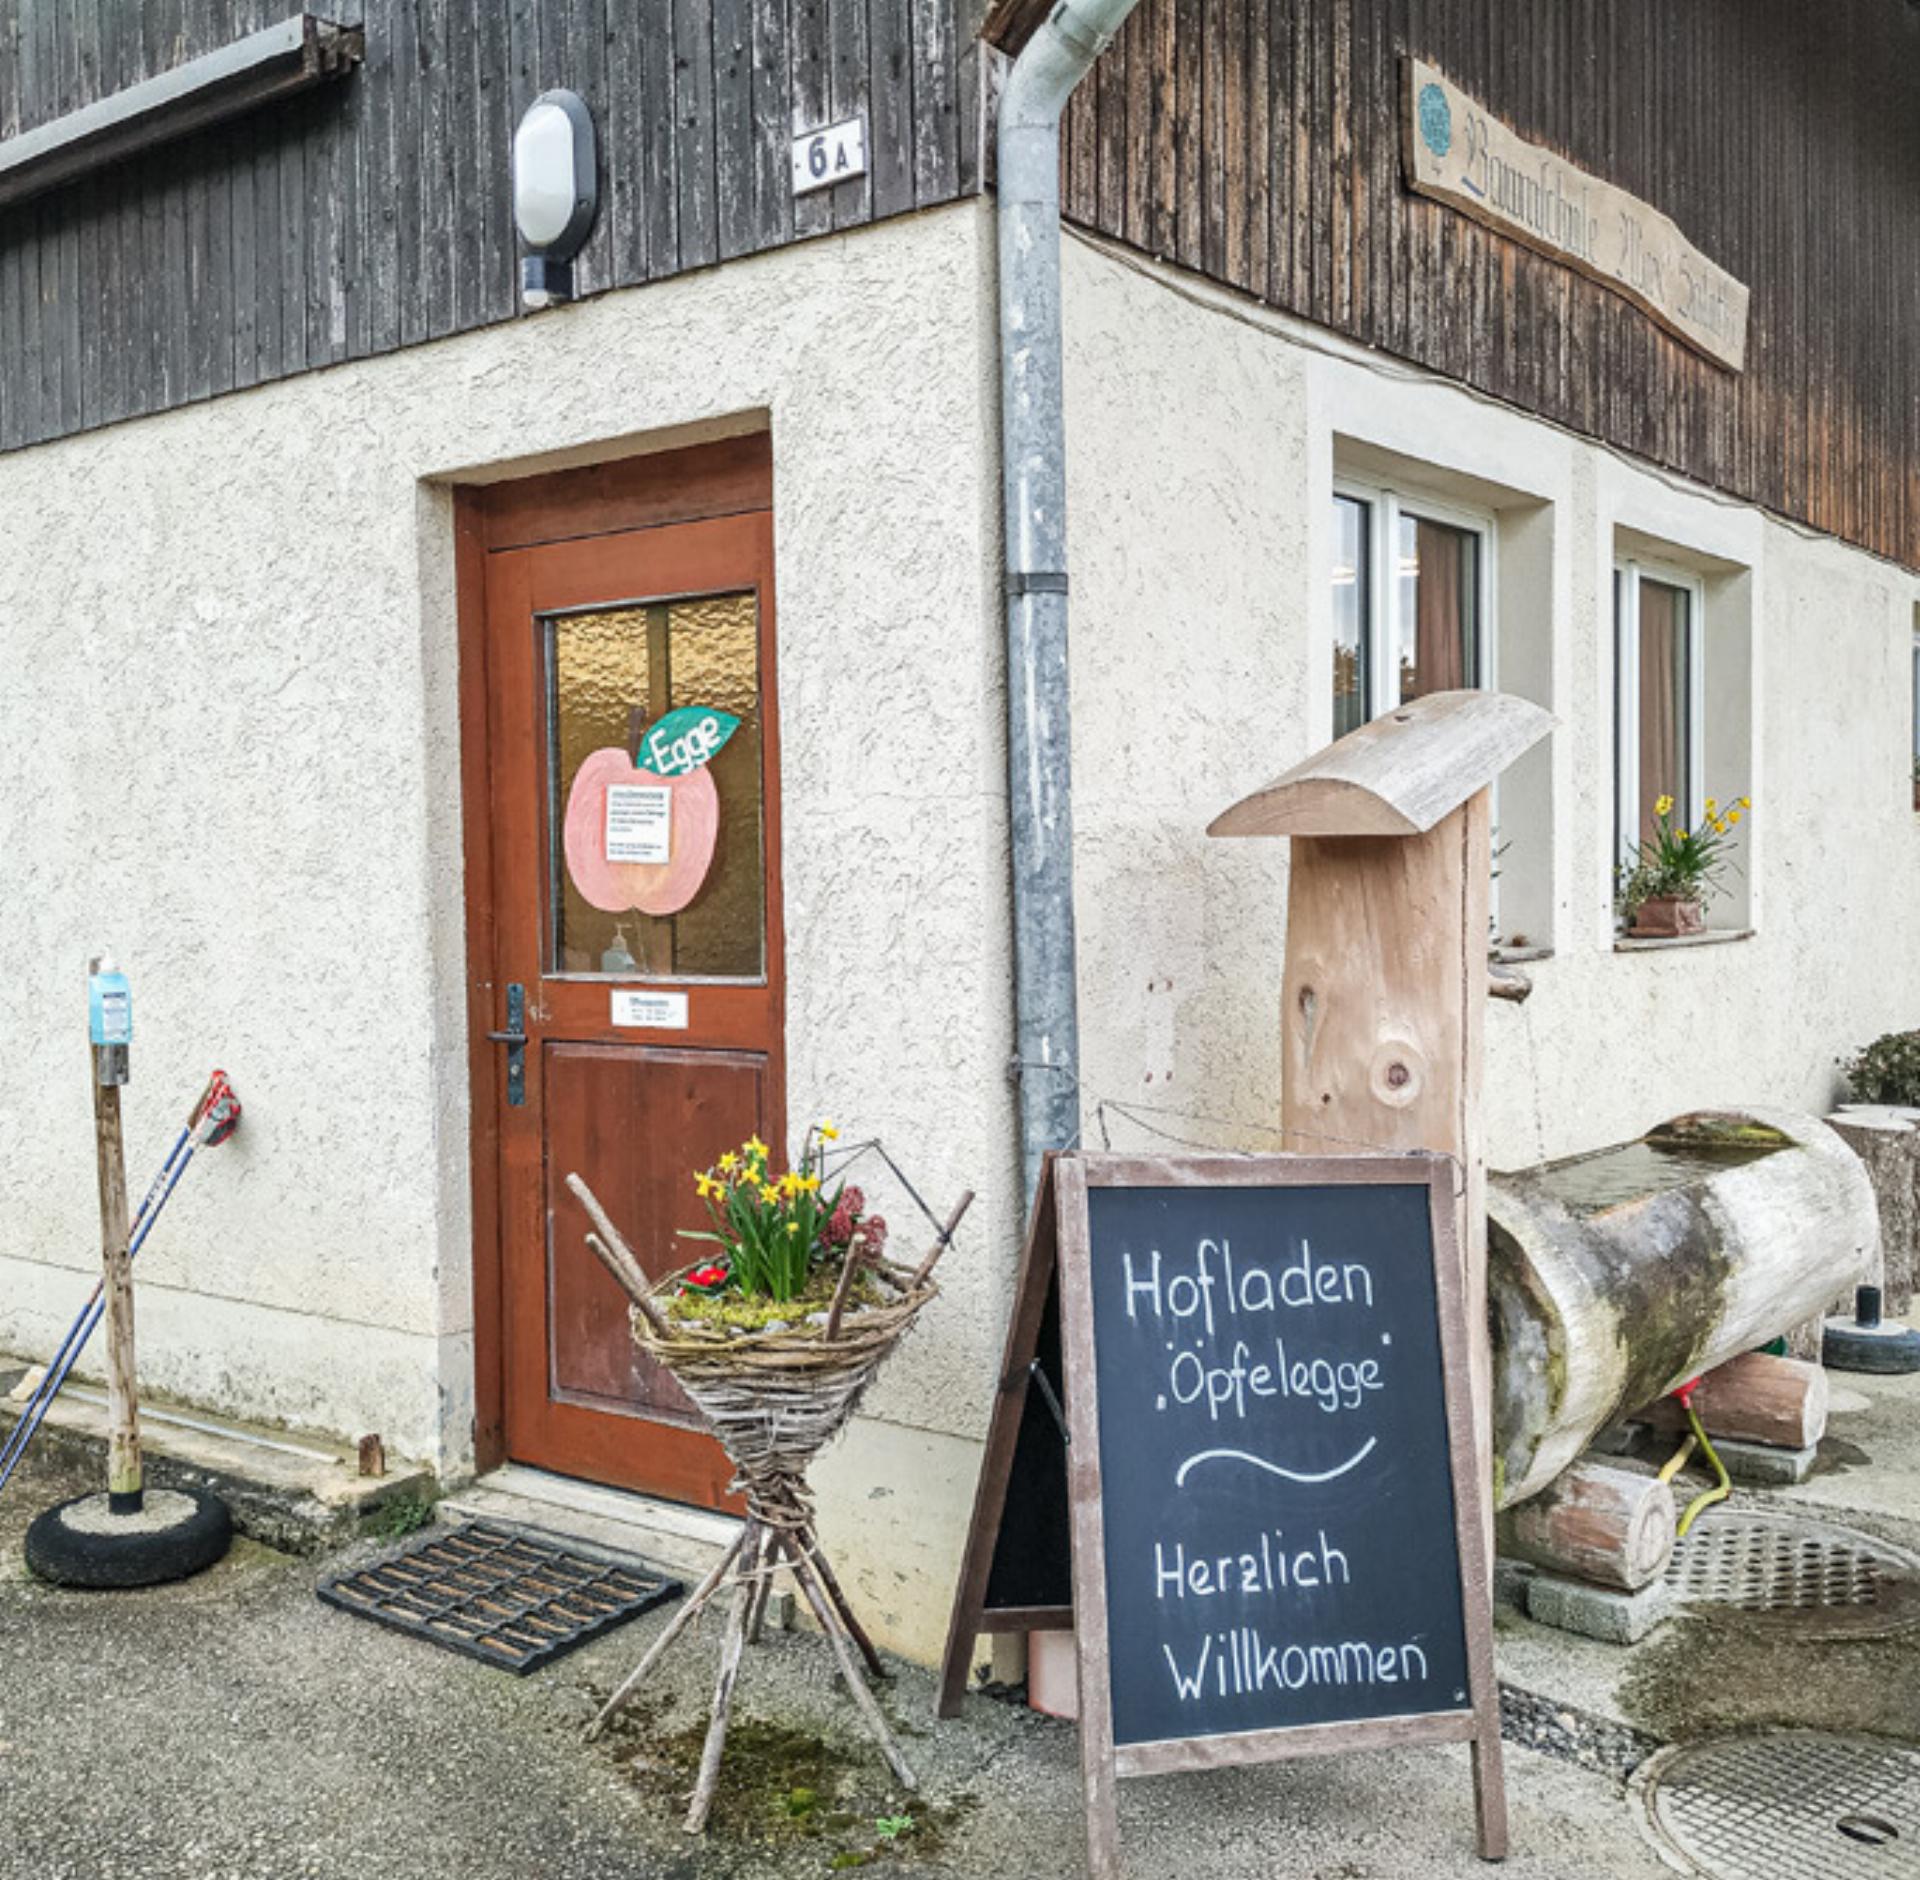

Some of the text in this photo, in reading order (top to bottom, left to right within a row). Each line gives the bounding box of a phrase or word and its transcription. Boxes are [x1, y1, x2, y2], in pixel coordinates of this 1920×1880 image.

[1123, 1239, 1373, 1334] Hofladen
[1155, 1531, 1350, 1599] Herzlich
[1164, 1627, 1427, 1699] Willkommen
